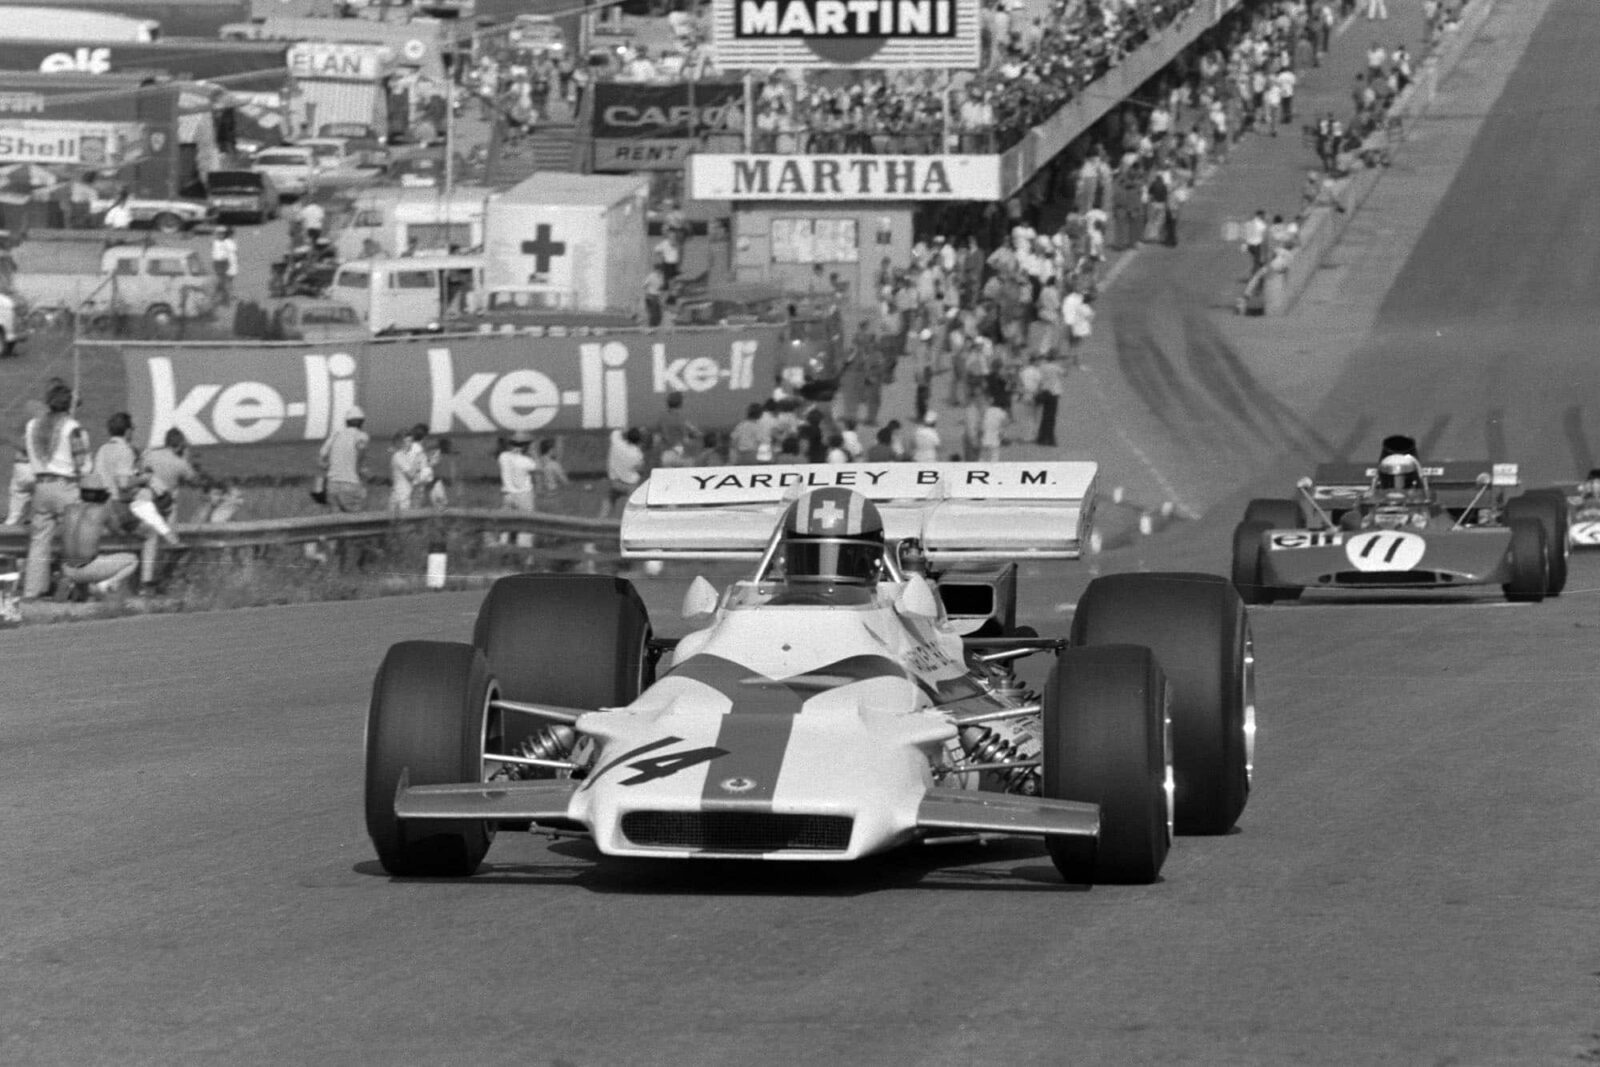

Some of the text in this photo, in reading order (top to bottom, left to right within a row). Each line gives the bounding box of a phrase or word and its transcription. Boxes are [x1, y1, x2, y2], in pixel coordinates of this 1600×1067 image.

[740, 0, 950, 34] MARTINI
[39, 47, 111, 73] elf
[616, 146, 678, 161] RENT
[733, 159, 952, 194] MARTHA
[652, 340, 758, 393] ke-li
[148, 352, 356, 447] ke-li
[427, 341, 629, 434] ke-li
[691, 470, 888, 490] YARDLEY
[1020, 470, 1057, 485] M.
[1360, 535, 1406, 563] 11
